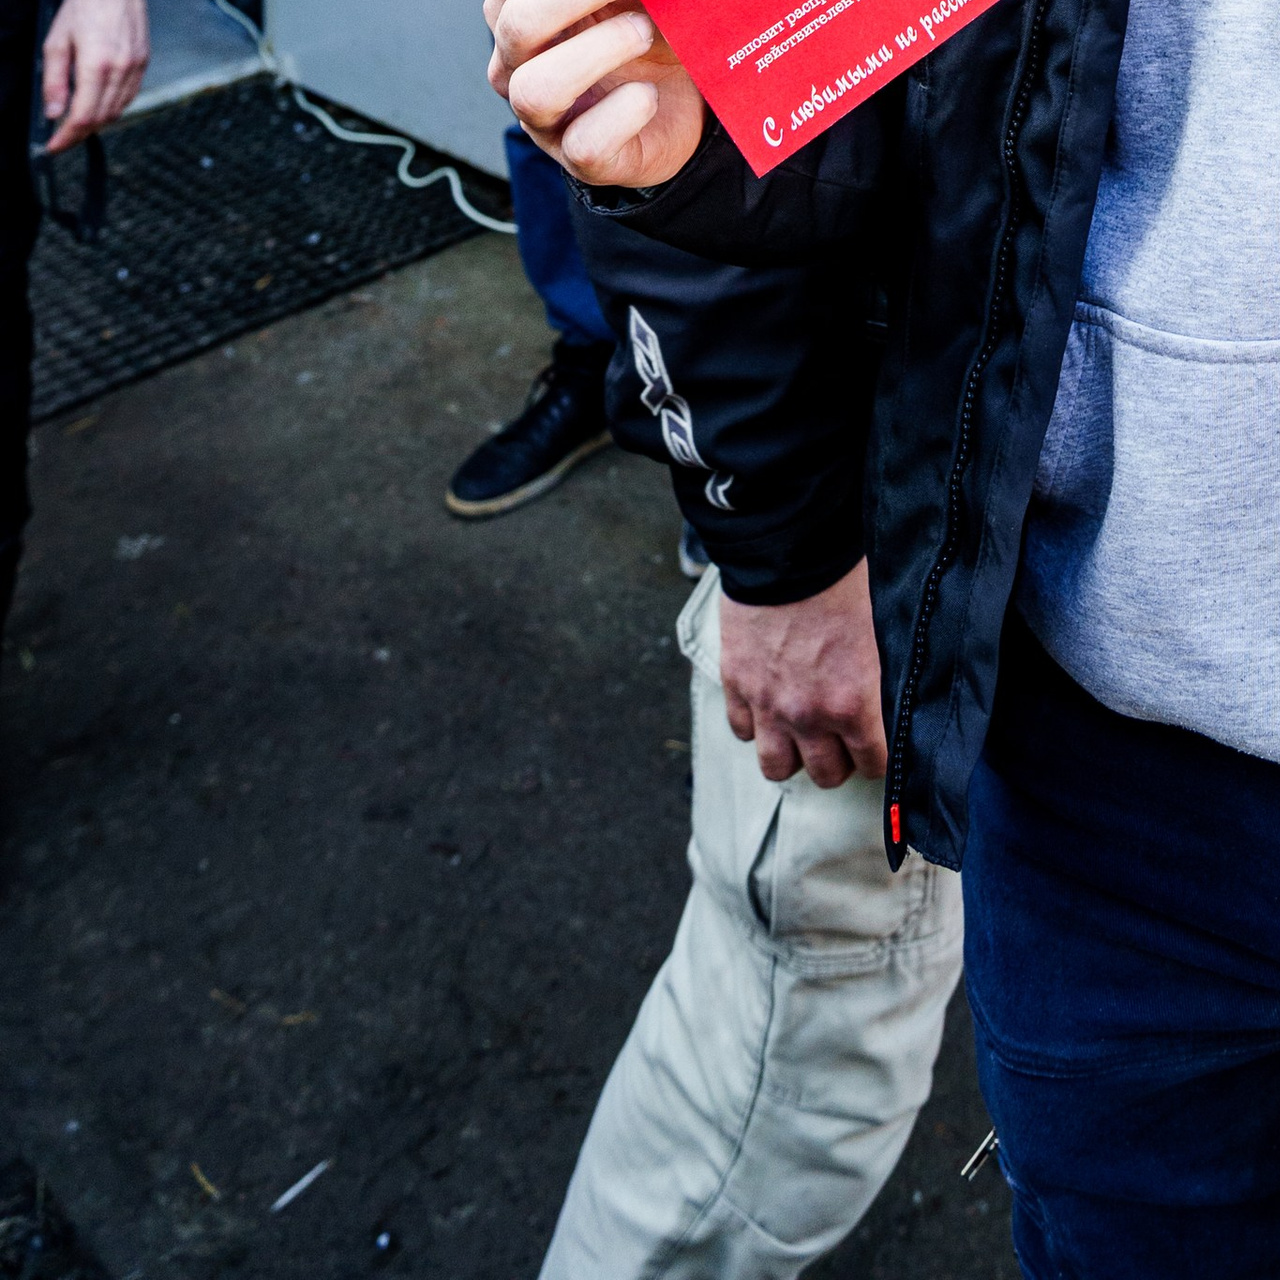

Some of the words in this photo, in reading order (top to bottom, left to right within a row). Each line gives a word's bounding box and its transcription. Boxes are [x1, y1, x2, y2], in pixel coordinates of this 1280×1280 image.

[726, 20, 785, 70] депозит
[762, 116, 783, 147] С
[790, 44, 893, 131] любимыми
[894, 25, 918, 51] не
